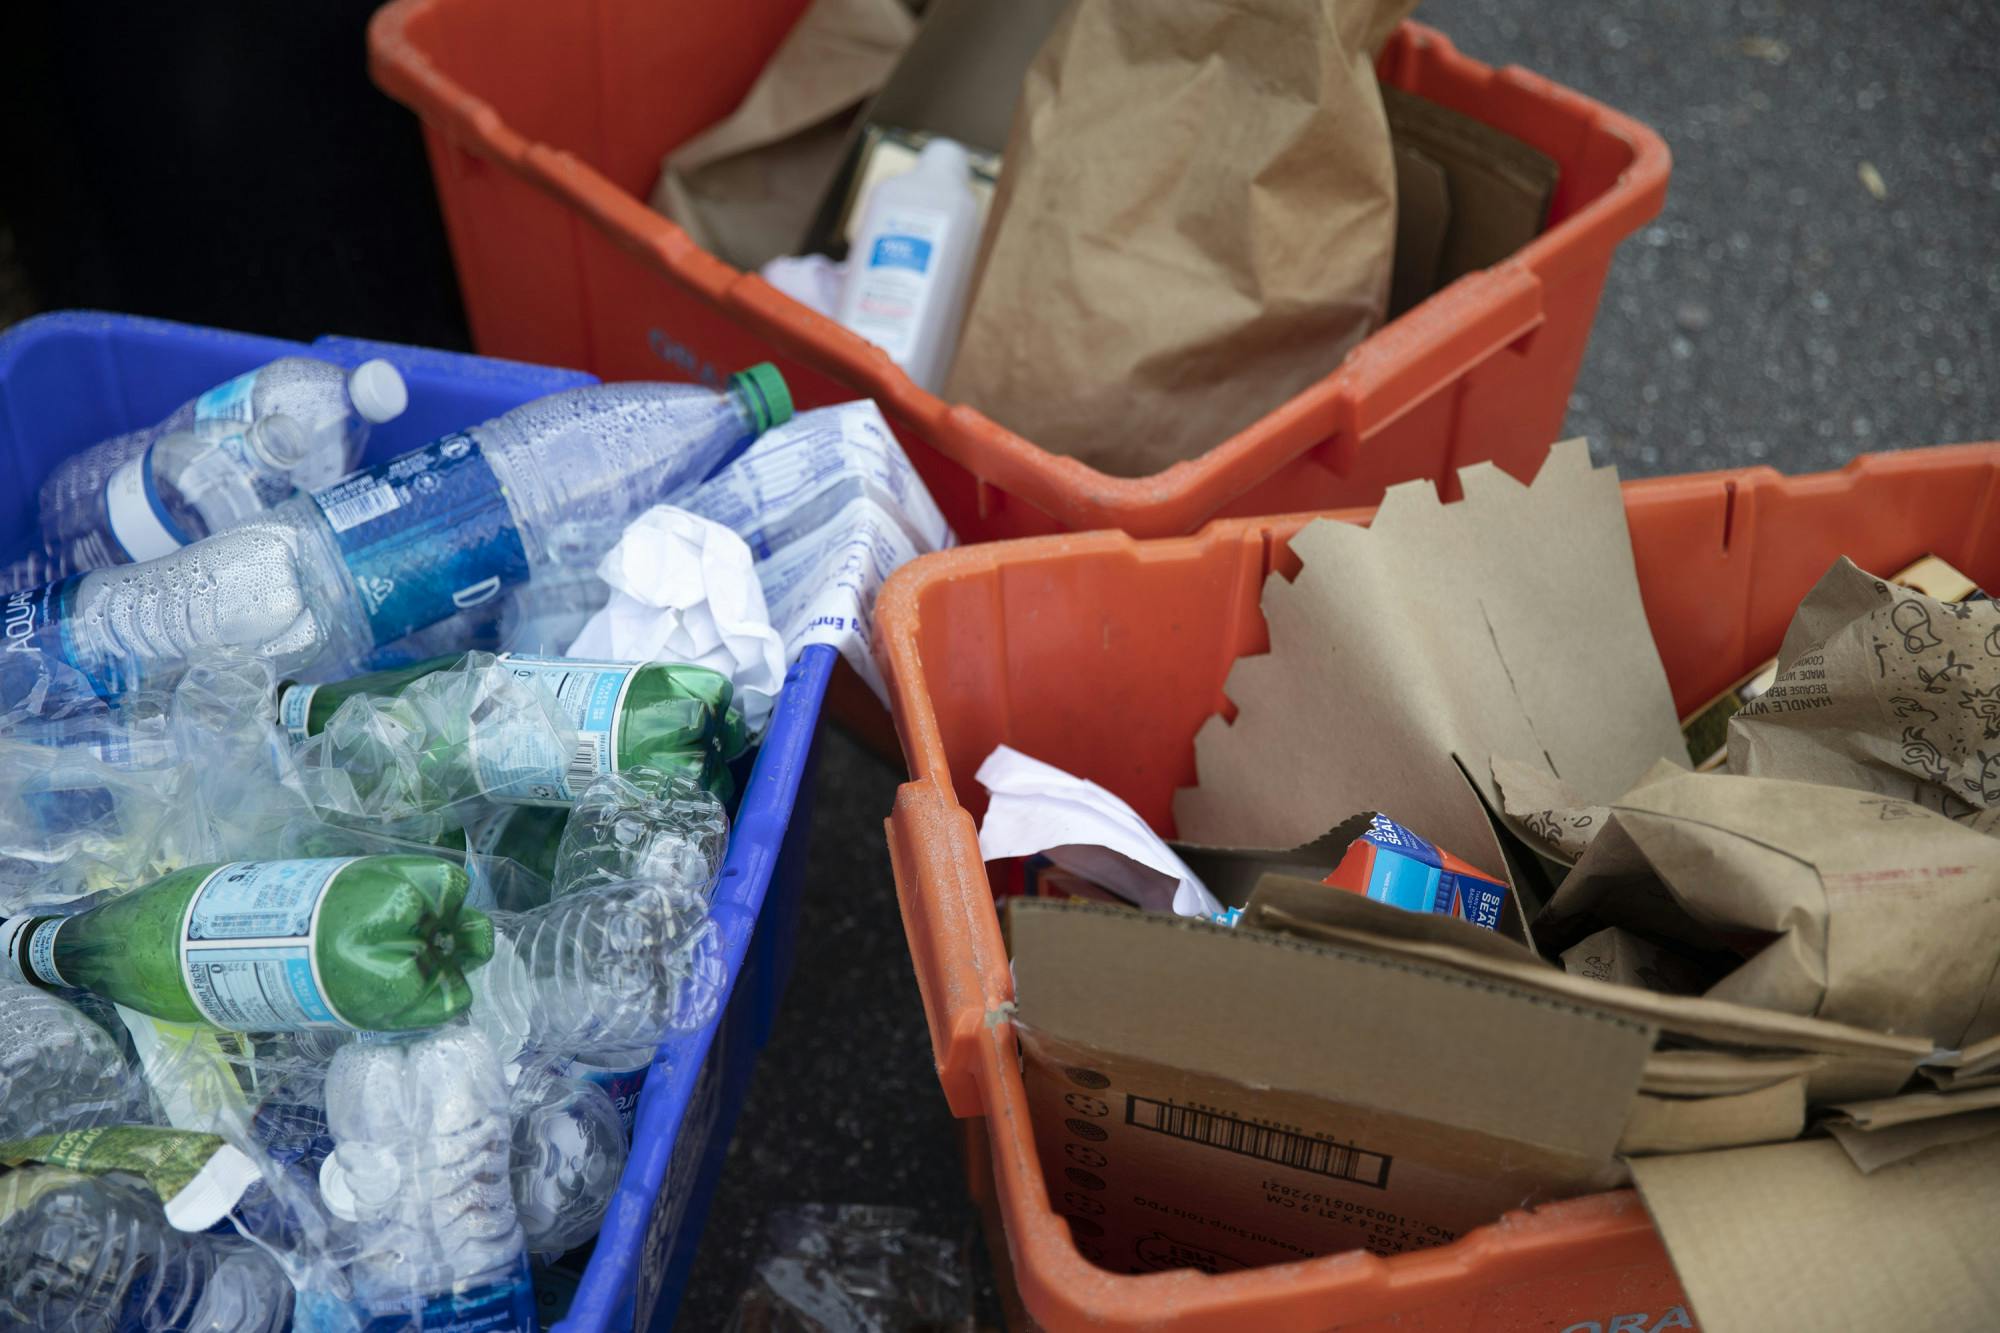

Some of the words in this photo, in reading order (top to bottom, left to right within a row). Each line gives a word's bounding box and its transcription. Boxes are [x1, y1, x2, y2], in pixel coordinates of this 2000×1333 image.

[1800, 669, 1825, 681] MADE
[1790, 684, 1828, 696] BECAUSE
[1738, 702, 1769, 716] WIT
[1772, 696, 1832, 713] HANDLE
[190, 963, 204, 990] Facts
[1266, 1193, 1296, 1209] CM
